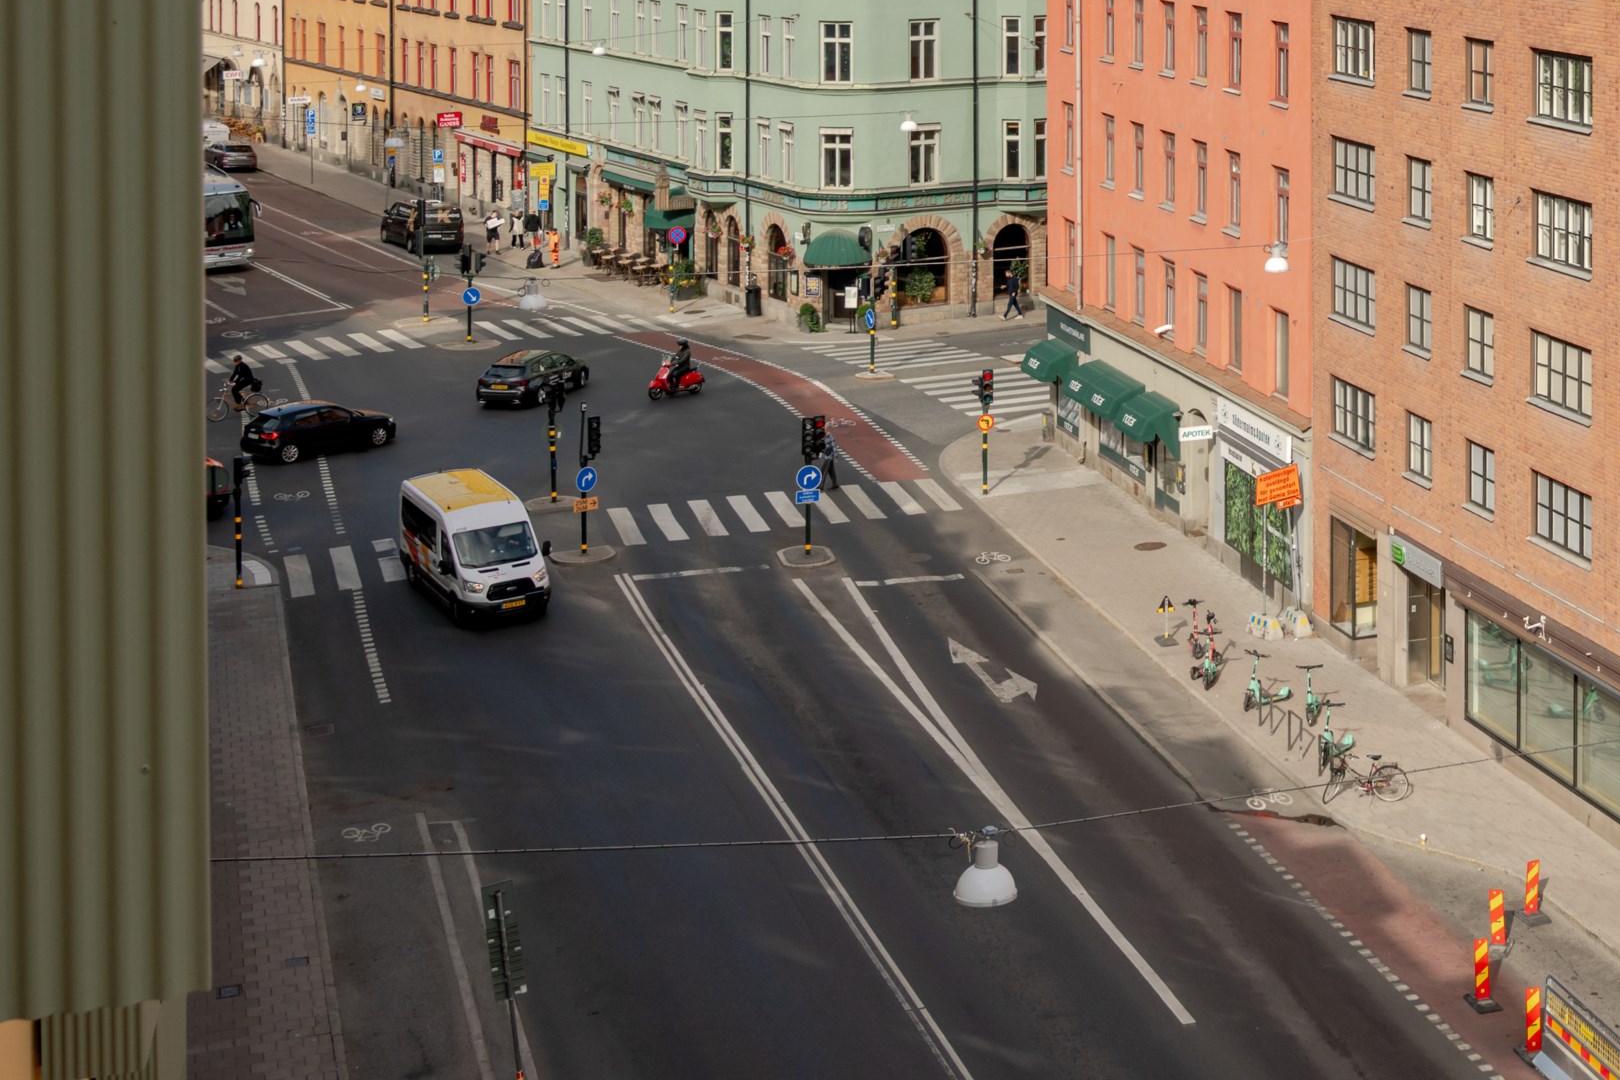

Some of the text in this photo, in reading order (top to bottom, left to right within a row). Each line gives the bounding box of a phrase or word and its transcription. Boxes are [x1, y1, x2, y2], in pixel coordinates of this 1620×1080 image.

[818, 199, 848, 211] PUB
[880, 192, 970, 210] THE BIG BEN
[1182, 429, 1211, 438] APOTEK
